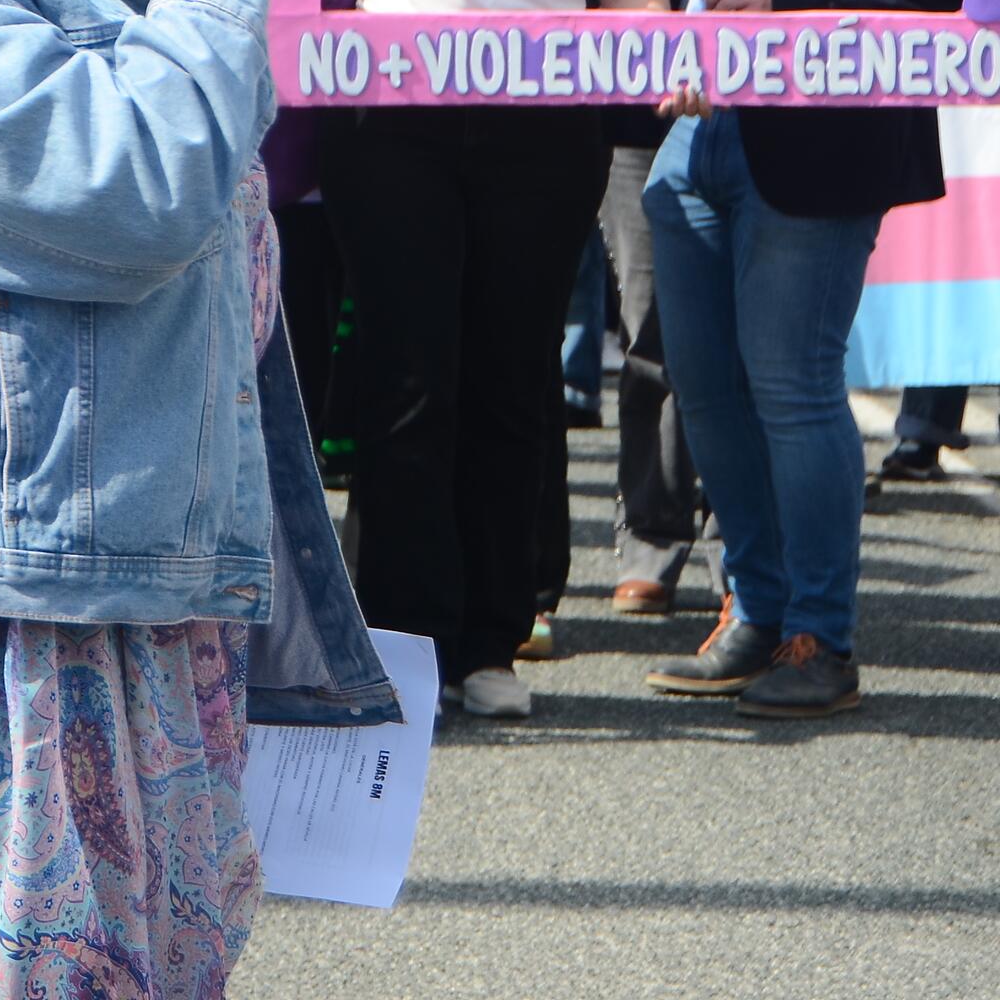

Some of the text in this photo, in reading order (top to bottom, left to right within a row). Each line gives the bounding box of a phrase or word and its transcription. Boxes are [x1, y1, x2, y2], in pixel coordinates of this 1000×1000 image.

[299, 28, 370, 96] NO
[415, 27, 703, 96] VIOLENCIA
[716, 27, 786, 96] DE
[793, 14, 1000, 97] GÉNERO
[369, 750, 391, 799] LEMAS 8M
